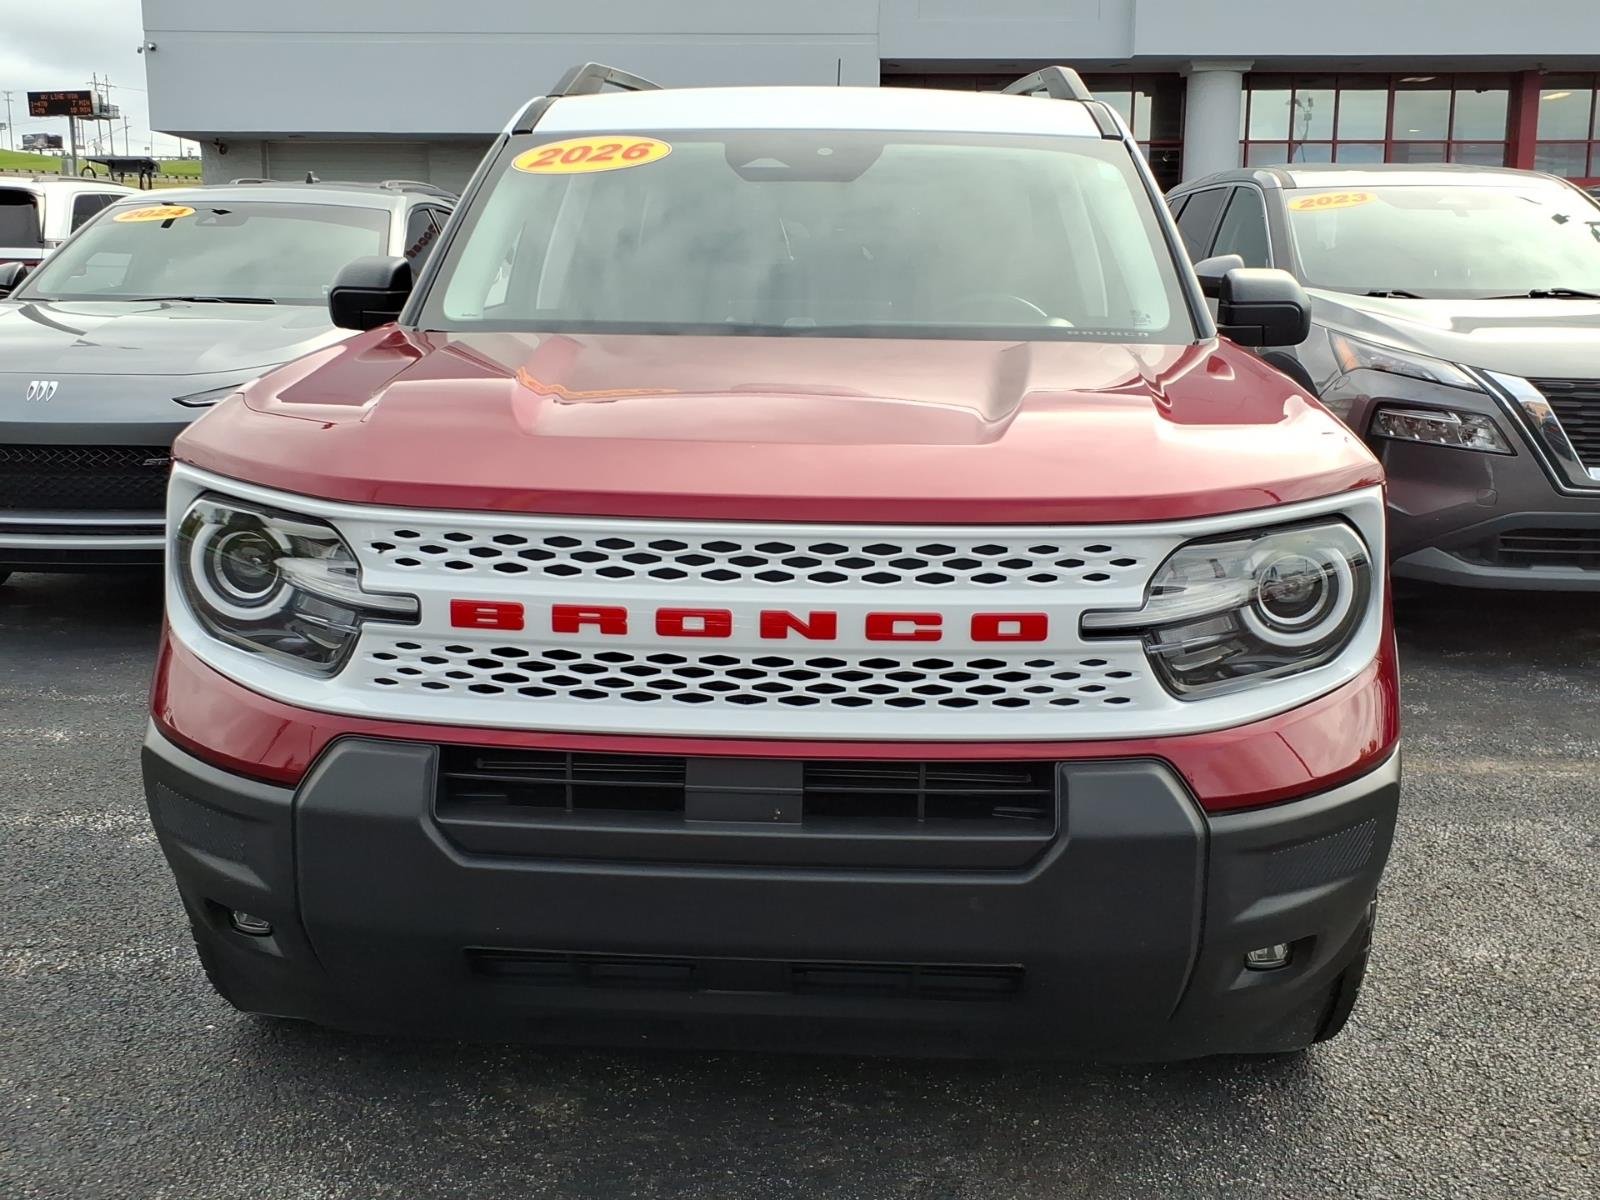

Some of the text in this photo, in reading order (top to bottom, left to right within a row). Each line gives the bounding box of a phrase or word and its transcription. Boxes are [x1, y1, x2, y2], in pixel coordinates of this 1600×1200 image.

[527, 142, 655, 169] 2026
[1299, 192, 1368, 209] 2023
[120, 207, 188, 220] 2024
[450, 599, 1049, 642] BRONCO
